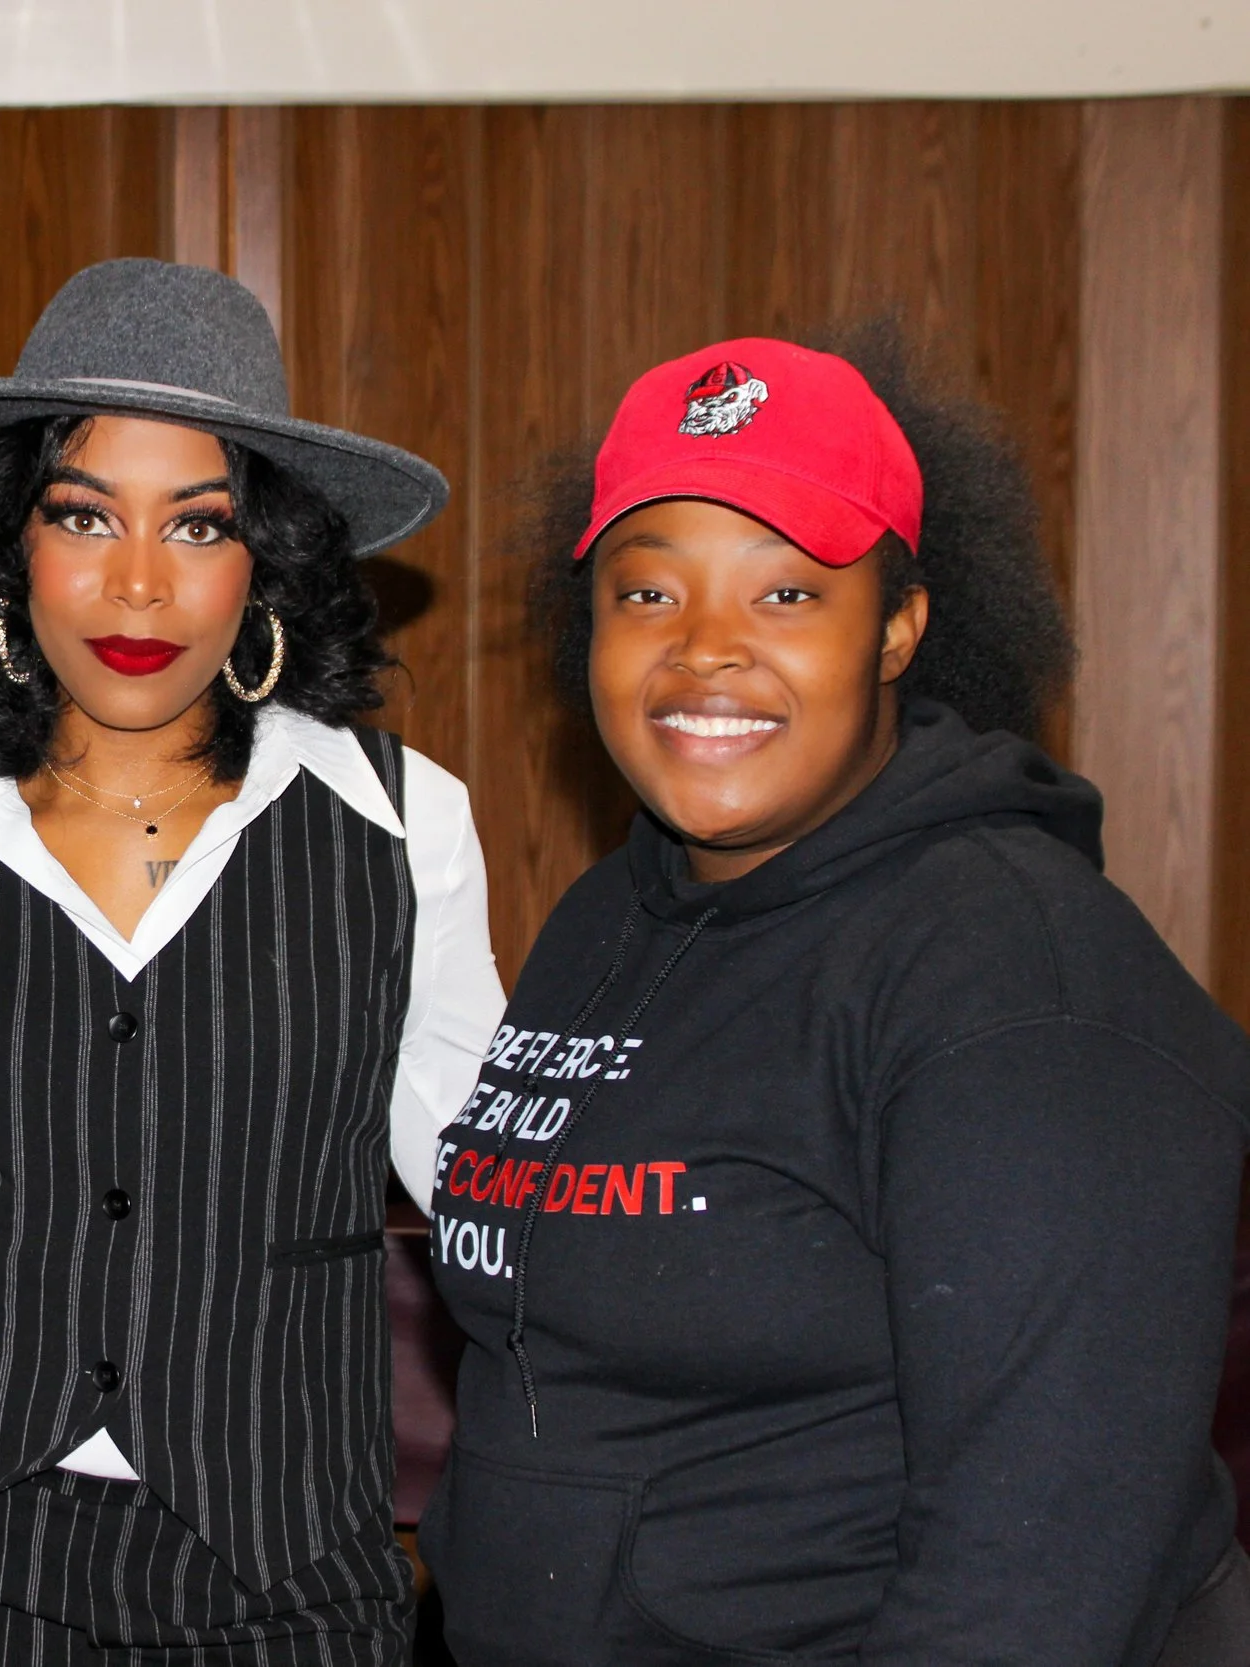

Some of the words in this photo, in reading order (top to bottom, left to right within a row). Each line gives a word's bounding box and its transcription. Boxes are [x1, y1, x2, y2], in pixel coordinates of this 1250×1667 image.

[482, 1024, 535, 1070] BE
[448, 1150, 707, 1216] CONFDENT.
[439, 1214, 513, 1279] YOU.
